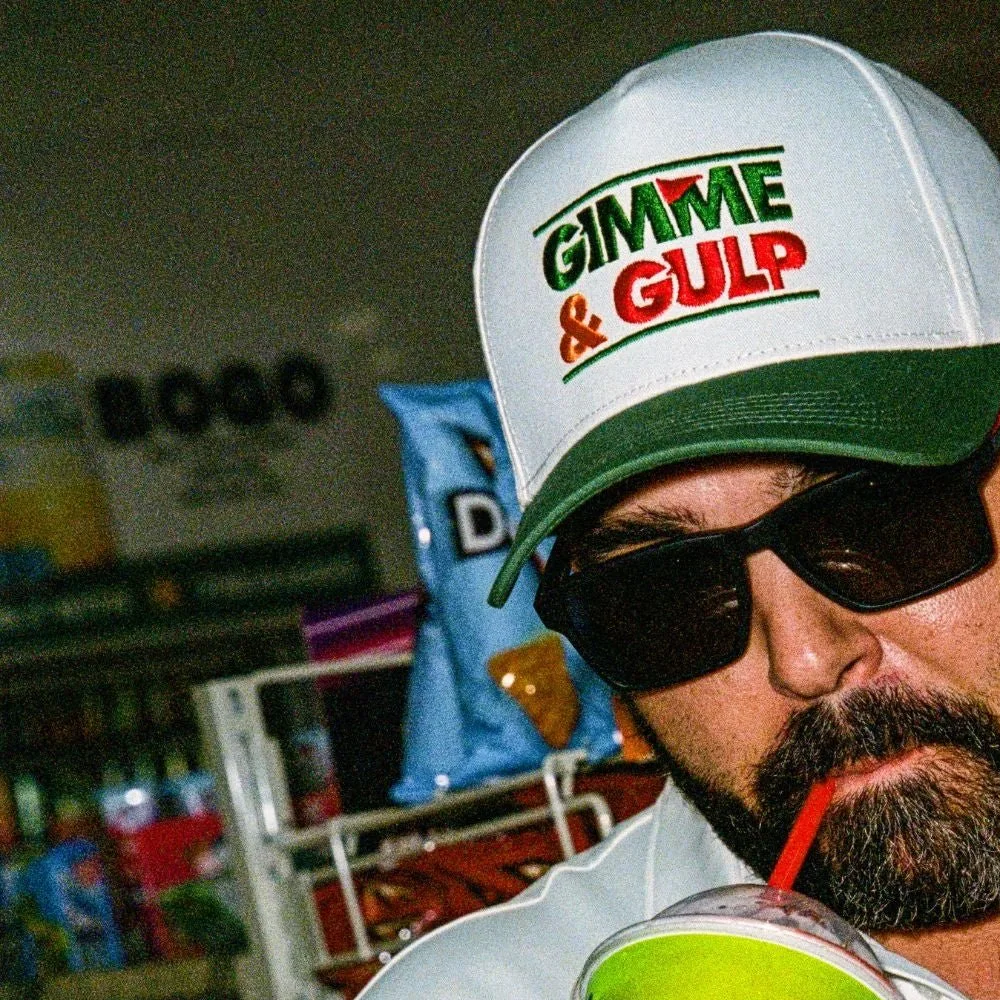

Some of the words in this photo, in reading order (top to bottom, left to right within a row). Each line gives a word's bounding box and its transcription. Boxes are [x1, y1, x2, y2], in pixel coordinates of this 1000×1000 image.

[543, 160, 793, 291] GIMME
[560, 293, 607, 364] &
[613, 230, 807, 324] GULP
[94, 354, 332, 442] BOGO
[450, 491, 516, 554] D
